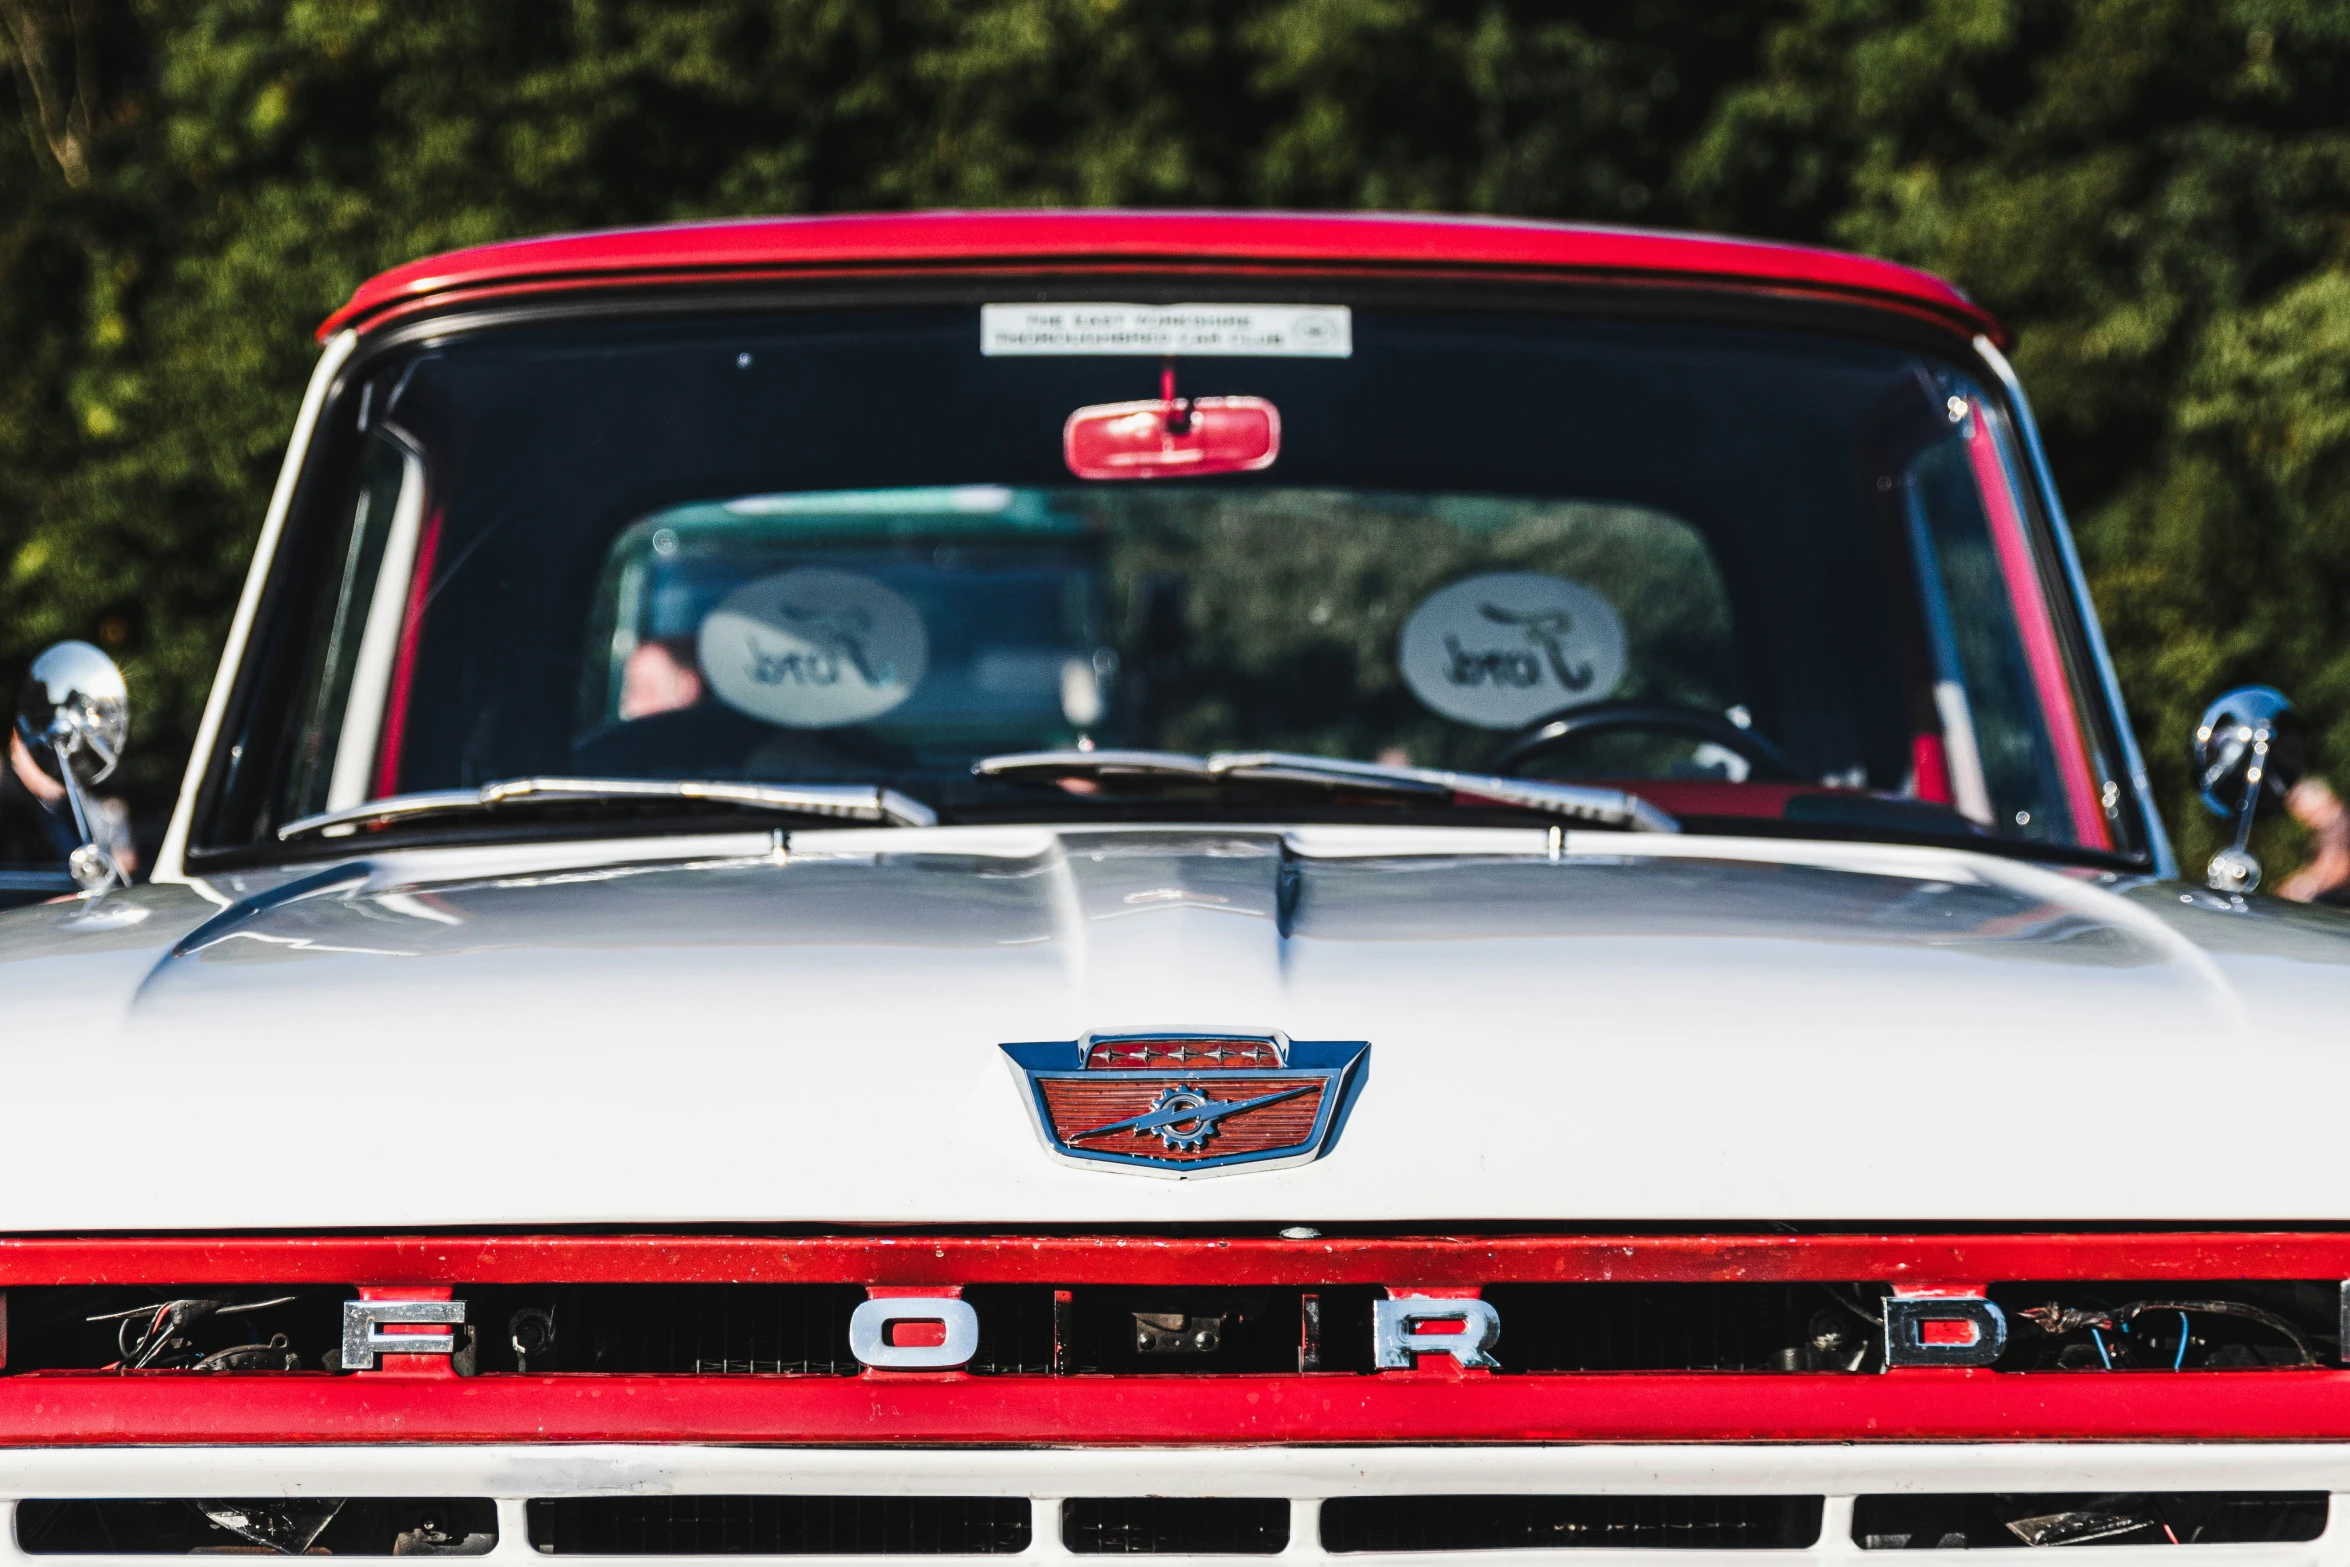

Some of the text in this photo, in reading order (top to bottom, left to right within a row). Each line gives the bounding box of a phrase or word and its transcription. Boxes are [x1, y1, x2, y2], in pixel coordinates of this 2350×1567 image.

[1026, 314, 1251, 327] THE EAST YORKSHIRE
[996, 332, 1286, 346] THOROUGHBRED CAR CLUB
[341, 1296, 2008, 1371] FORD
